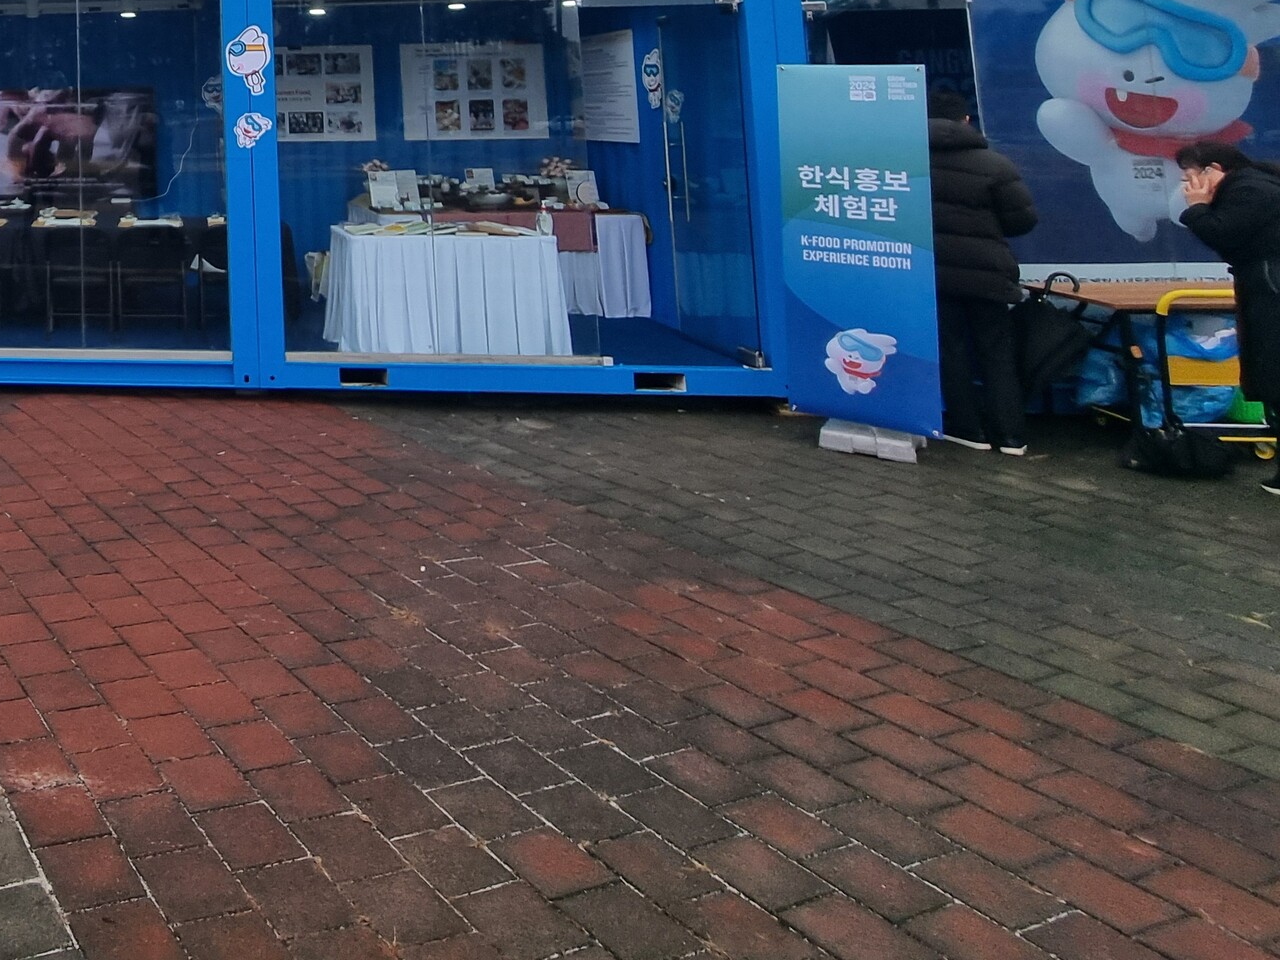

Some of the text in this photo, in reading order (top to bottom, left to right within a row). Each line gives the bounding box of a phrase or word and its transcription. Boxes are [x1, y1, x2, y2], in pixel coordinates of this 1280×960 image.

[797, 165, 911, 192] 한식홍보
[814, 194, 898, 222] 체험관
[801, 234, 912, 255] K-FOOD PROMOTION
[803, 249, 911, 270] EXPERIENCE BOOTH
